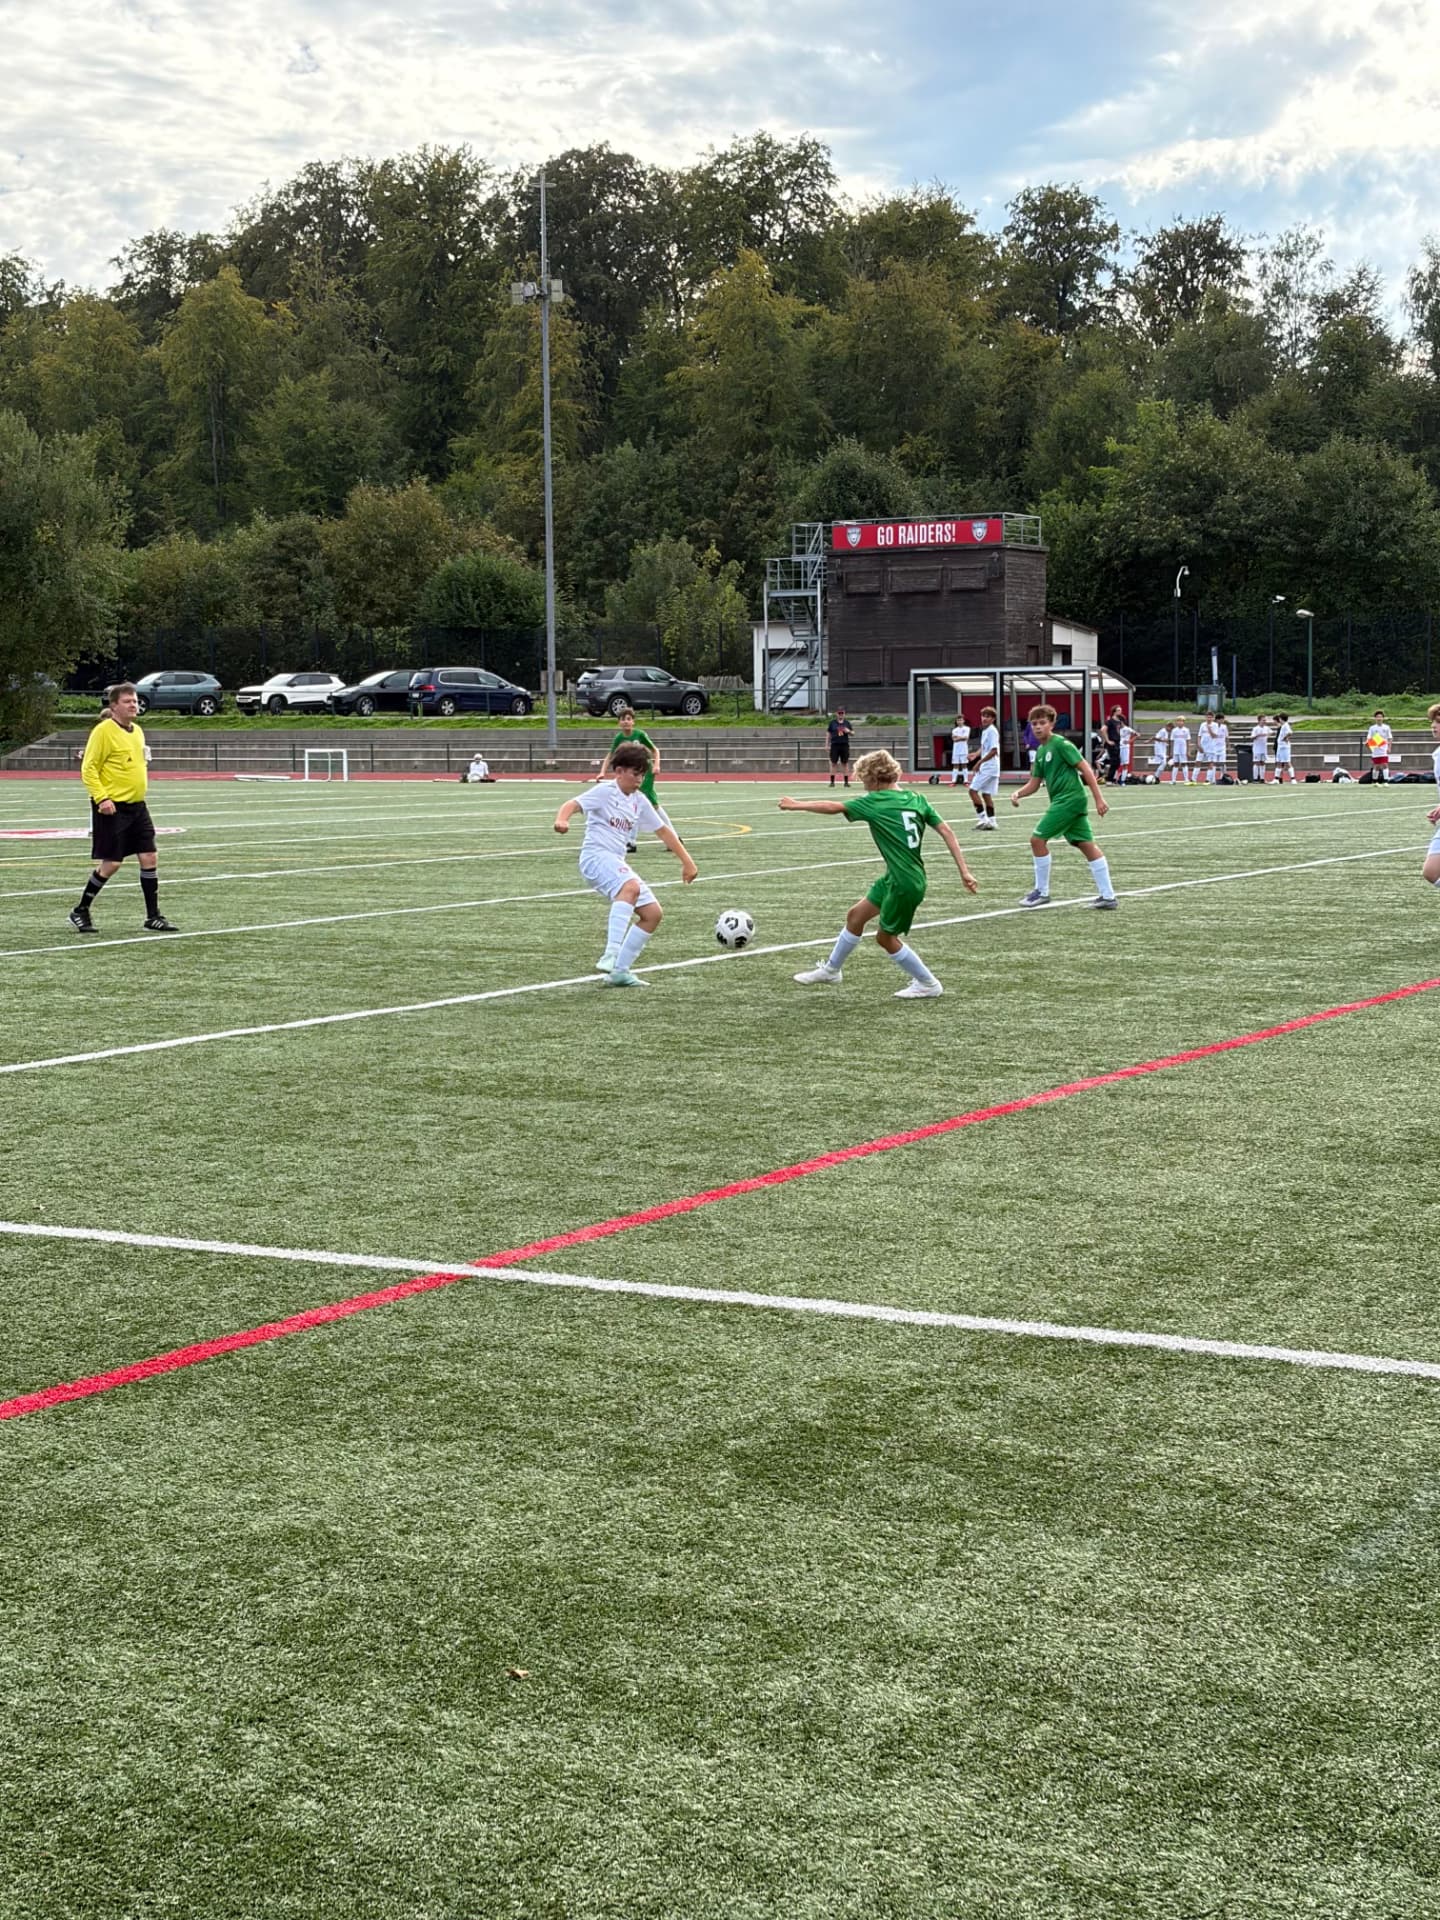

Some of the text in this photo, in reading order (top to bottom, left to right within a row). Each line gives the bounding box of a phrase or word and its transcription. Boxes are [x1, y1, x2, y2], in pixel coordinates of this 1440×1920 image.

[877, 526, 894, 546] GO
[898, 524, 956, 545] RAIDERS!
[901, 810, 920, 849] 5
